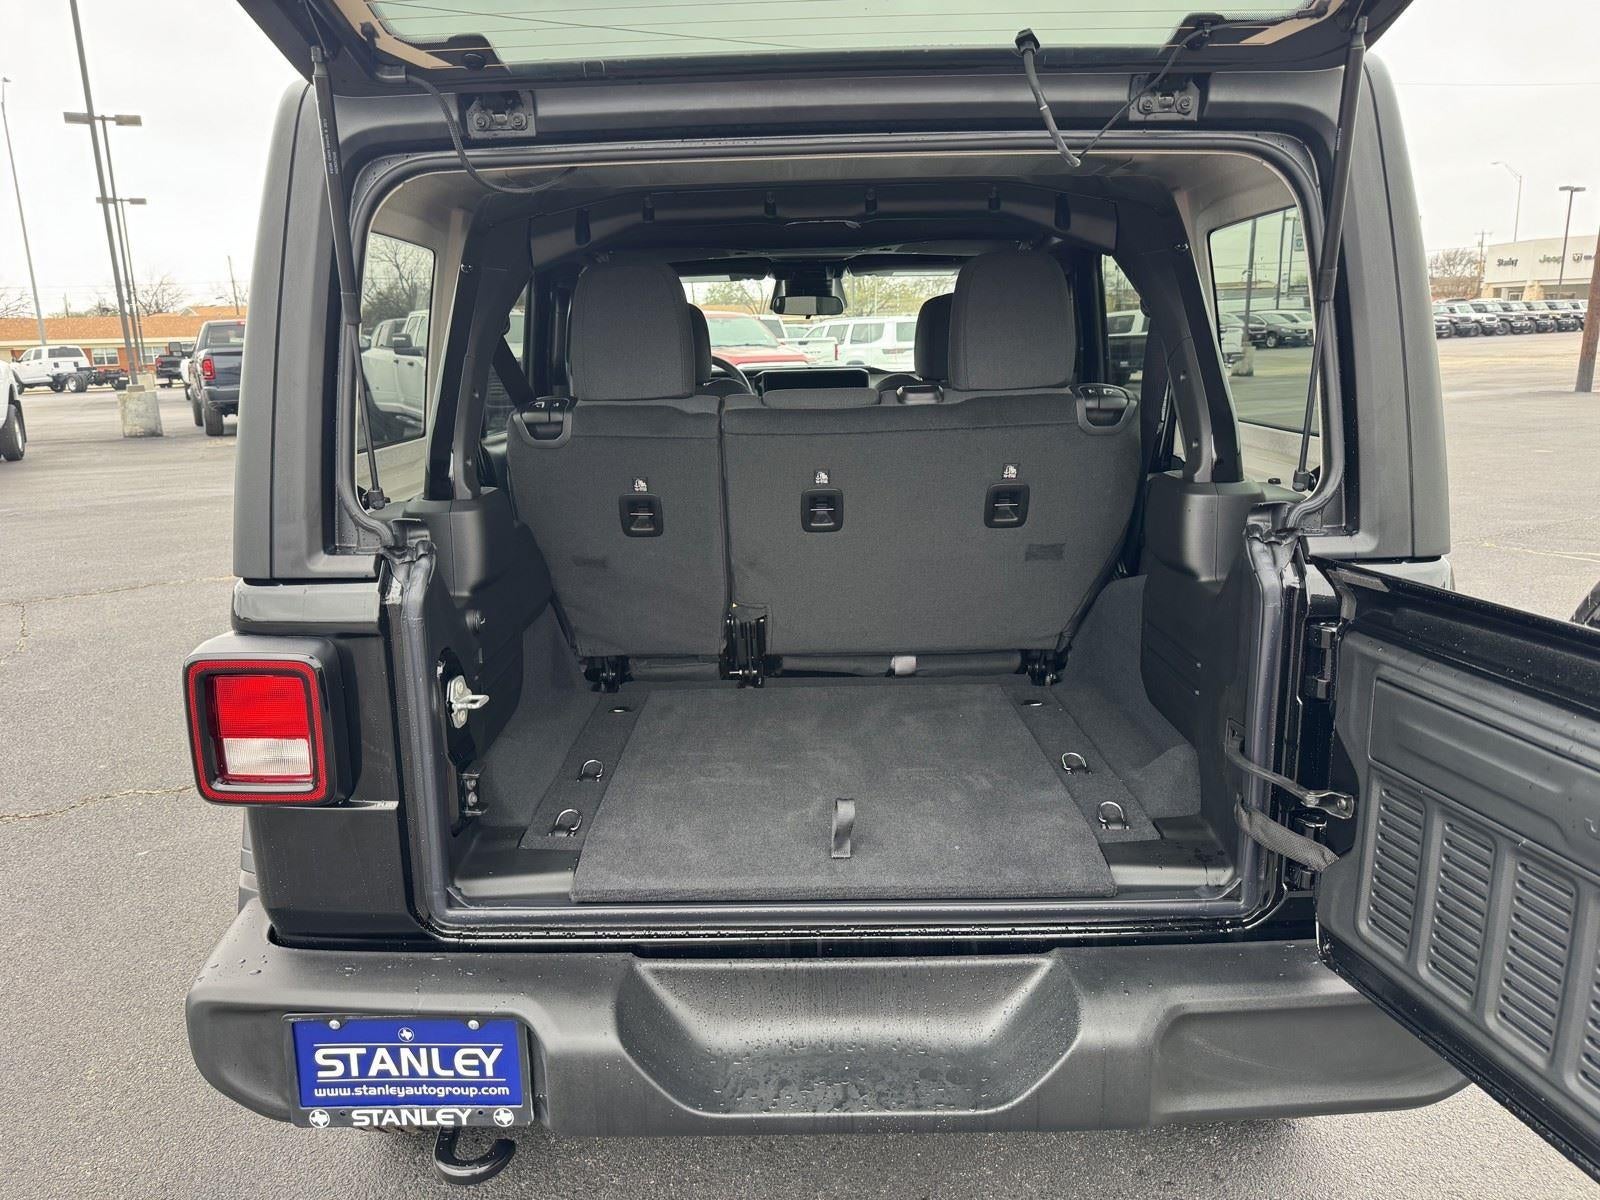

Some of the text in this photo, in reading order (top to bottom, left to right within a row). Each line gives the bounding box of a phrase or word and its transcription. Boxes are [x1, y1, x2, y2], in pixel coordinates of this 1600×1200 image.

[314, 1047, 503, 1077] STANLEY
[314, 1084, 510, 1097] www.stanleyautogroup.com
[351, 1108, 471, 1126] STANLEY
